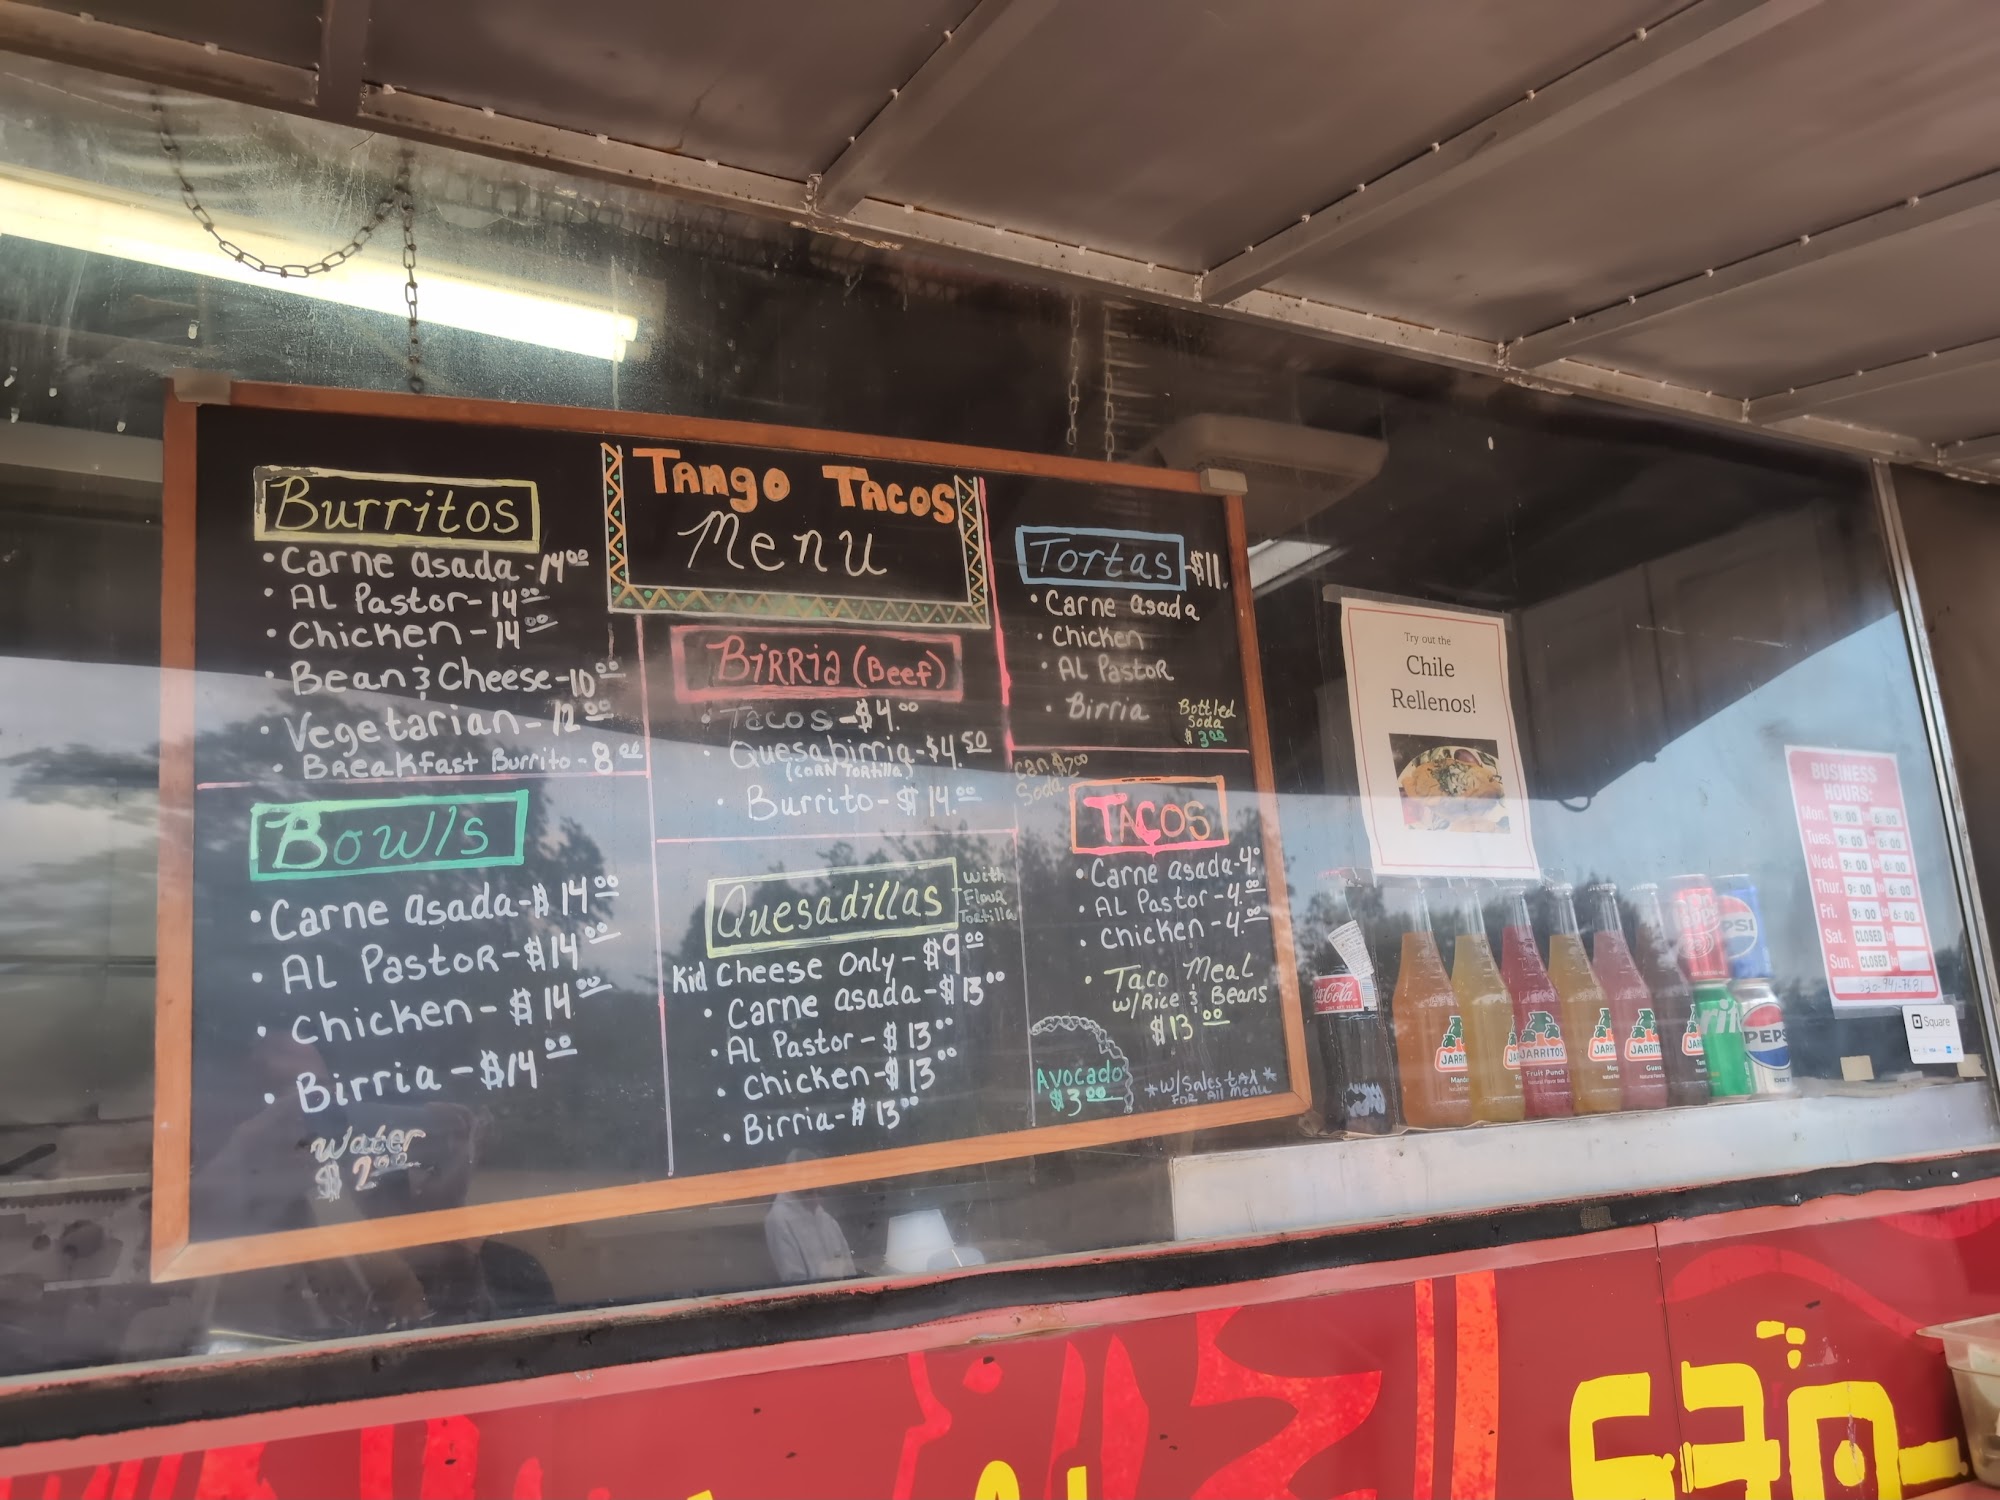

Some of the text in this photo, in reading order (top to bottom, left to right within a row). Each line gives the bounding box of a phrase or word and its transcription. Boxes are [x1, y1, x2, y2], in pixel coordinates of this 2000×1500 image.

[270, 476, 520, 534] Burritos
[677, 510, 887, 576] Menu
[281, 546, 395, 578] Carne
[1029, 537, 1172, 580] Tortas
[1045, 590, 1117, 618] Carne
[289, 621, 462, 649] Chicken
[1052, 625, 1144, 650] Chicken
[1404, 632, 1451, 646] Try out the
[290, 660, 406, 695] Bean
[439, 657, 552, 691] Cheese
[1406, 655, 1455, 678] Chile
[1066, 692, 1150, 721] Birria
[1178, 698, 1236, 718] Bottled
[1390, 688, 1476, 714] Rellenos!
[284, 704, 520, 757] Vegetarian
[720, 706, 833, 732] Tacos
[1188, 715, 1224, 728] Soda
[492, 747, 571, 772] Burrito
[730, 735, 915, 769] Quesabirria
[1810, 762, 1878, 783] BUSINESS
[746, 784, 874, 821] Burrito
[1016, 775, 1064, 806] Soda
[1823, 783, 1872, 803] HOURS:
[1801, 805, 1828, 821] Mon.
[265, 805, 490, 869] Bowls
[1805, 830, 1835, 845] Tues.
[1091, 858, 1158, 888] Carne
[1810, 854, 1838, 869] Wed.
[1138, 886, 1208, 914] Pastor
[1815, 879, 1842, 894] Thur.
[270, 899, 389, 941] Carne
[717, 879, 943, 938] Quesadillas
[1820, 903, 1838, 918] Fri.
[1100, 917, 1204, 950] Chicken
[1825, 928, 1847, 944] Sat.
[1855, 930, 1883, 942] CLOSED
[672, 961, 707, 994] Kid
[717, 957, 823, 987] Cheese
[839, 947, 894, 980] Only
[1104, 952, 1254, 993] Taco Meal
[1829, 953, 1854, 969] Sun.
[1860, 955, 1887, 968] CLOSED
[1212, 985, 1268, 1005] Beans
[292, 999, 472, 1044] Chicken
[728, 995, 819, 1030] Carne
[1924, 1016, 1950, 1028] Square
[774, 1018, 854, 1059] Pastor
[1520, 1048, 1563, 1059] JARRITOS
[295, 1065, 442, 1113] Birria
[744, 1064, 870, 1100] Chicken
